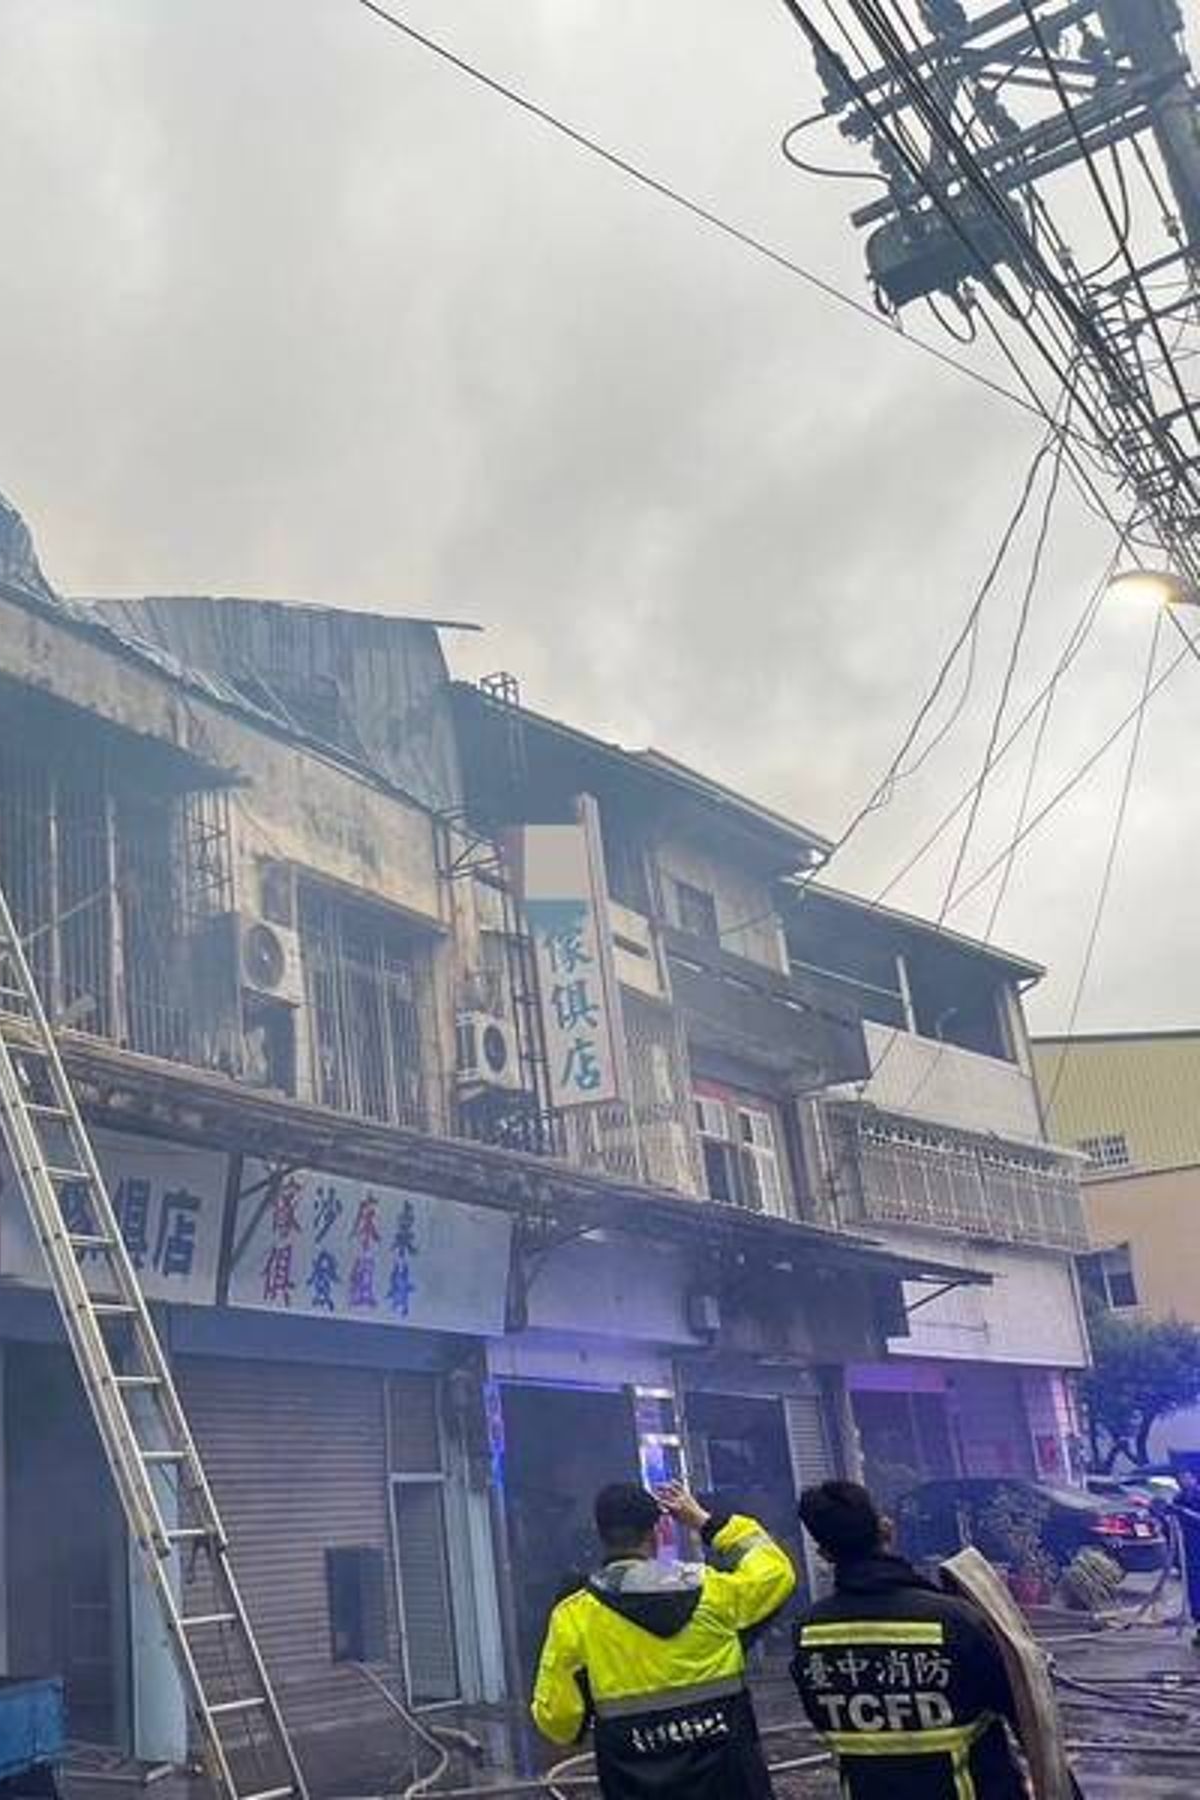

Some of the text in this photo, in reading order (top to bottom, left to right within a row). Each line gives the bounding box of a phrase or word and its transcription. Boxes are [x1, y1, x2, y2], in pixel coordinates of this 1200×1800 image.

[802, 1648, 951, 1689] 臺中消防
[816, 1691, 954, 1730] TCFD
